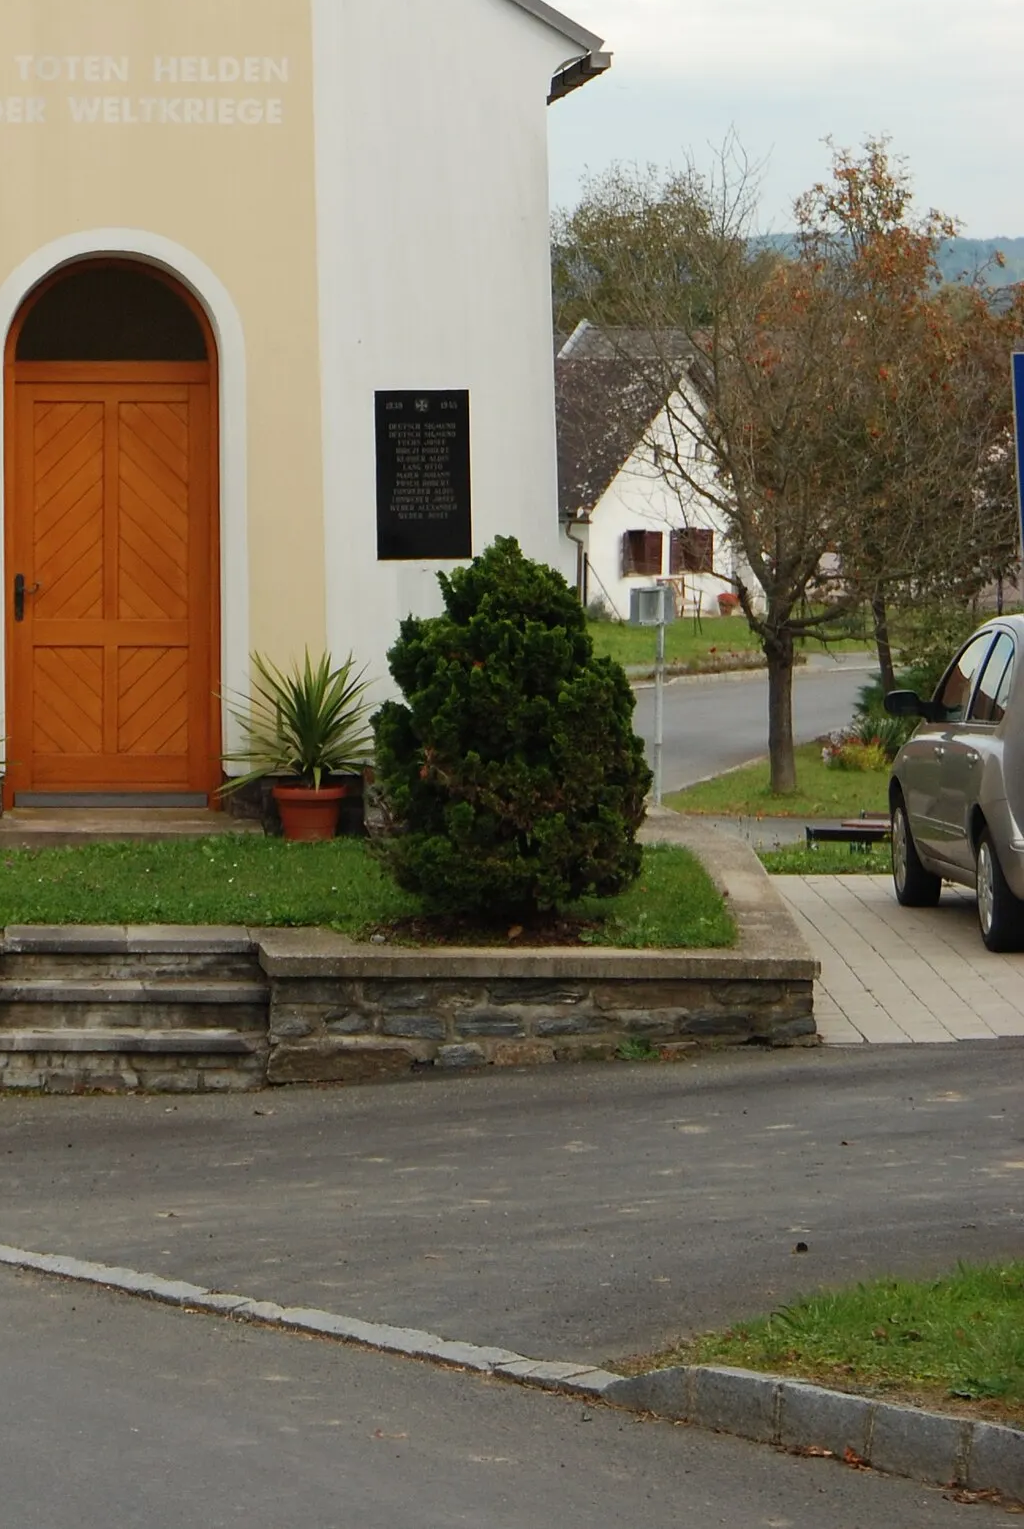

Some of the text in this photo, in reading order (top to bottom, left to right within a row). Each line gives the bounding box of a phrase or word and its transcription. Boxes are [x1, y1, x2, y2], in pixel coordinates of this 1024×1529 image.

[14, 55, 129, 82] TOTEN
[154, 55, 289, 83] HELDEN
[67, 96, 282, 124] WELTKRIEGE
